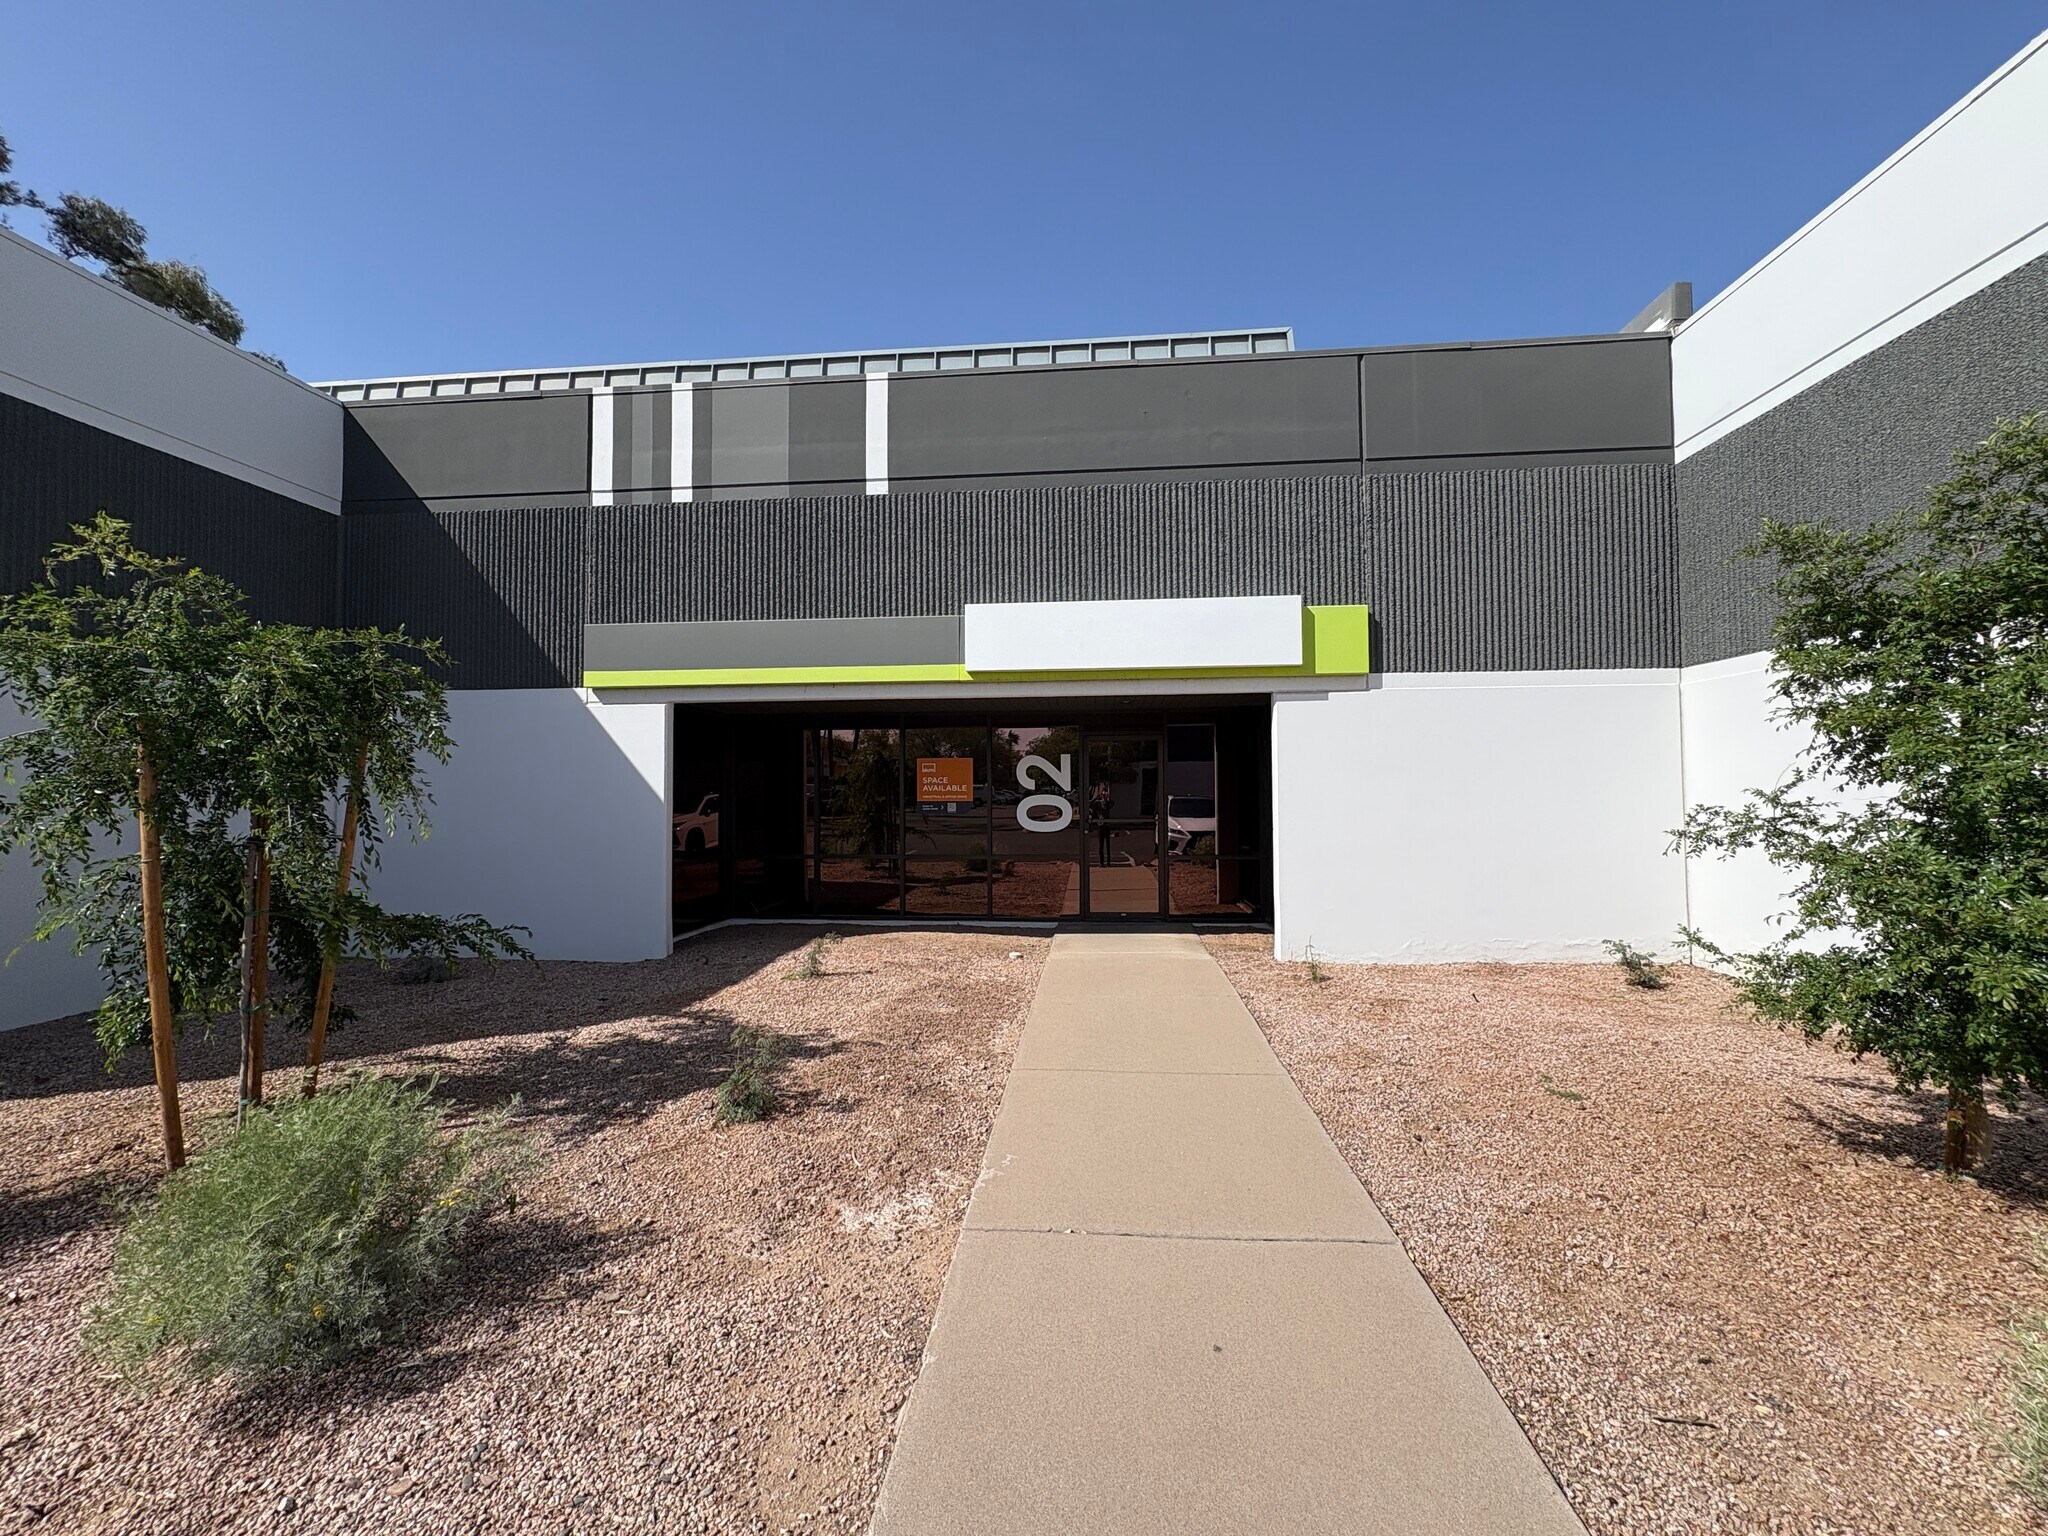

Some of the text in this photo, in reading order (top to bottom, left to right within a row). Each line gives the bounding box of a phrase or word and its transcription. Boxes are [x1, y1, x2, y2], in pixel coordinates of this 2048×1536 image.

[922, 776, 949, 784] SPACE
[922, 784, 967, 792] AVAILABLE
[1016, 753, 1072, 833] 02
